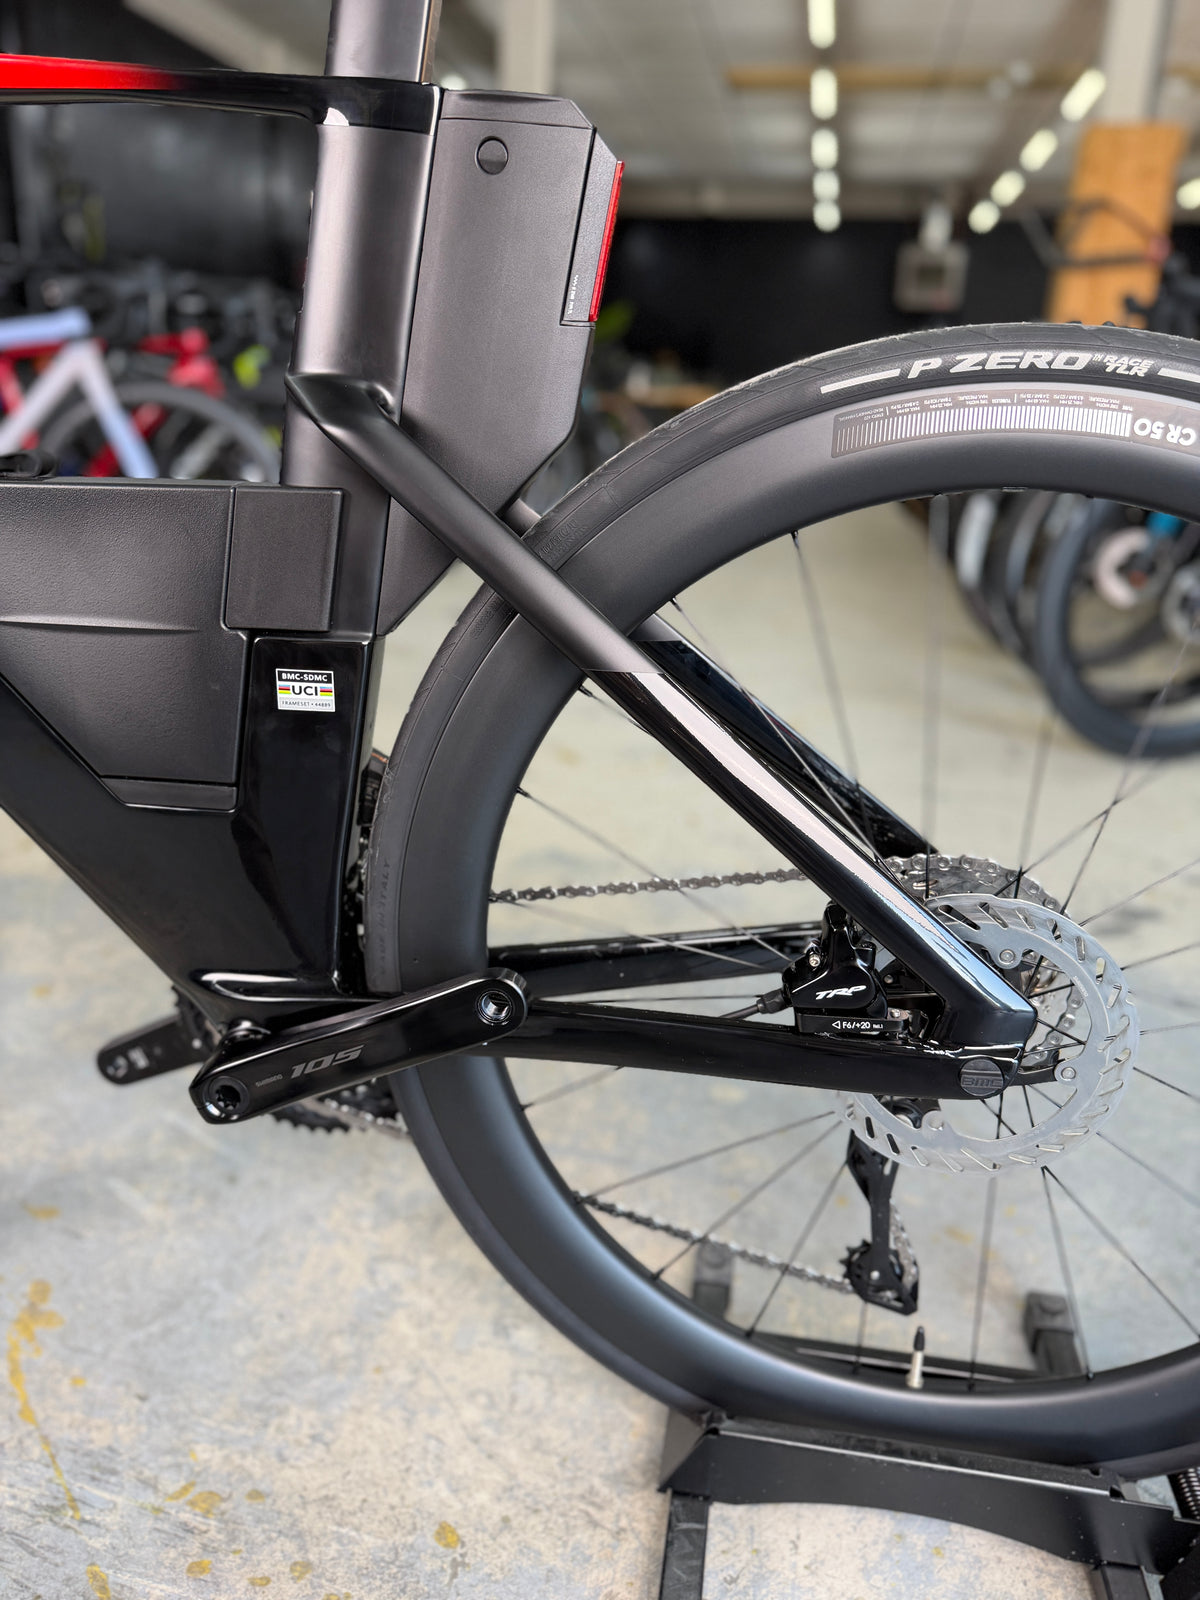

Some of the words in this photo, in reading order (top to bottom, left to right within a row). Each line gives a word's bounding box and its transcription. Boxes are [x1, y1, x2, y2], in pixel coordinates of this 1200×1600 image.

[907, 357, 942, 379] P
[950, 351, 1093, 373] ZERO
[1103, 355, 1154, 368] RACE
[1105, 362, 1149, 377] TLR
[1133, 418, 1165, 441] 50
[1166, 423, 1197, 447] CR
[281, 672, 328, 682] BMC-SDMC
[292, 685, 318, 696] UCI
[815, 985, 867, 1000] TRP
[842, 1021, 871, 1029] F6/+20
[291, 1044, 365, 1079] 105
